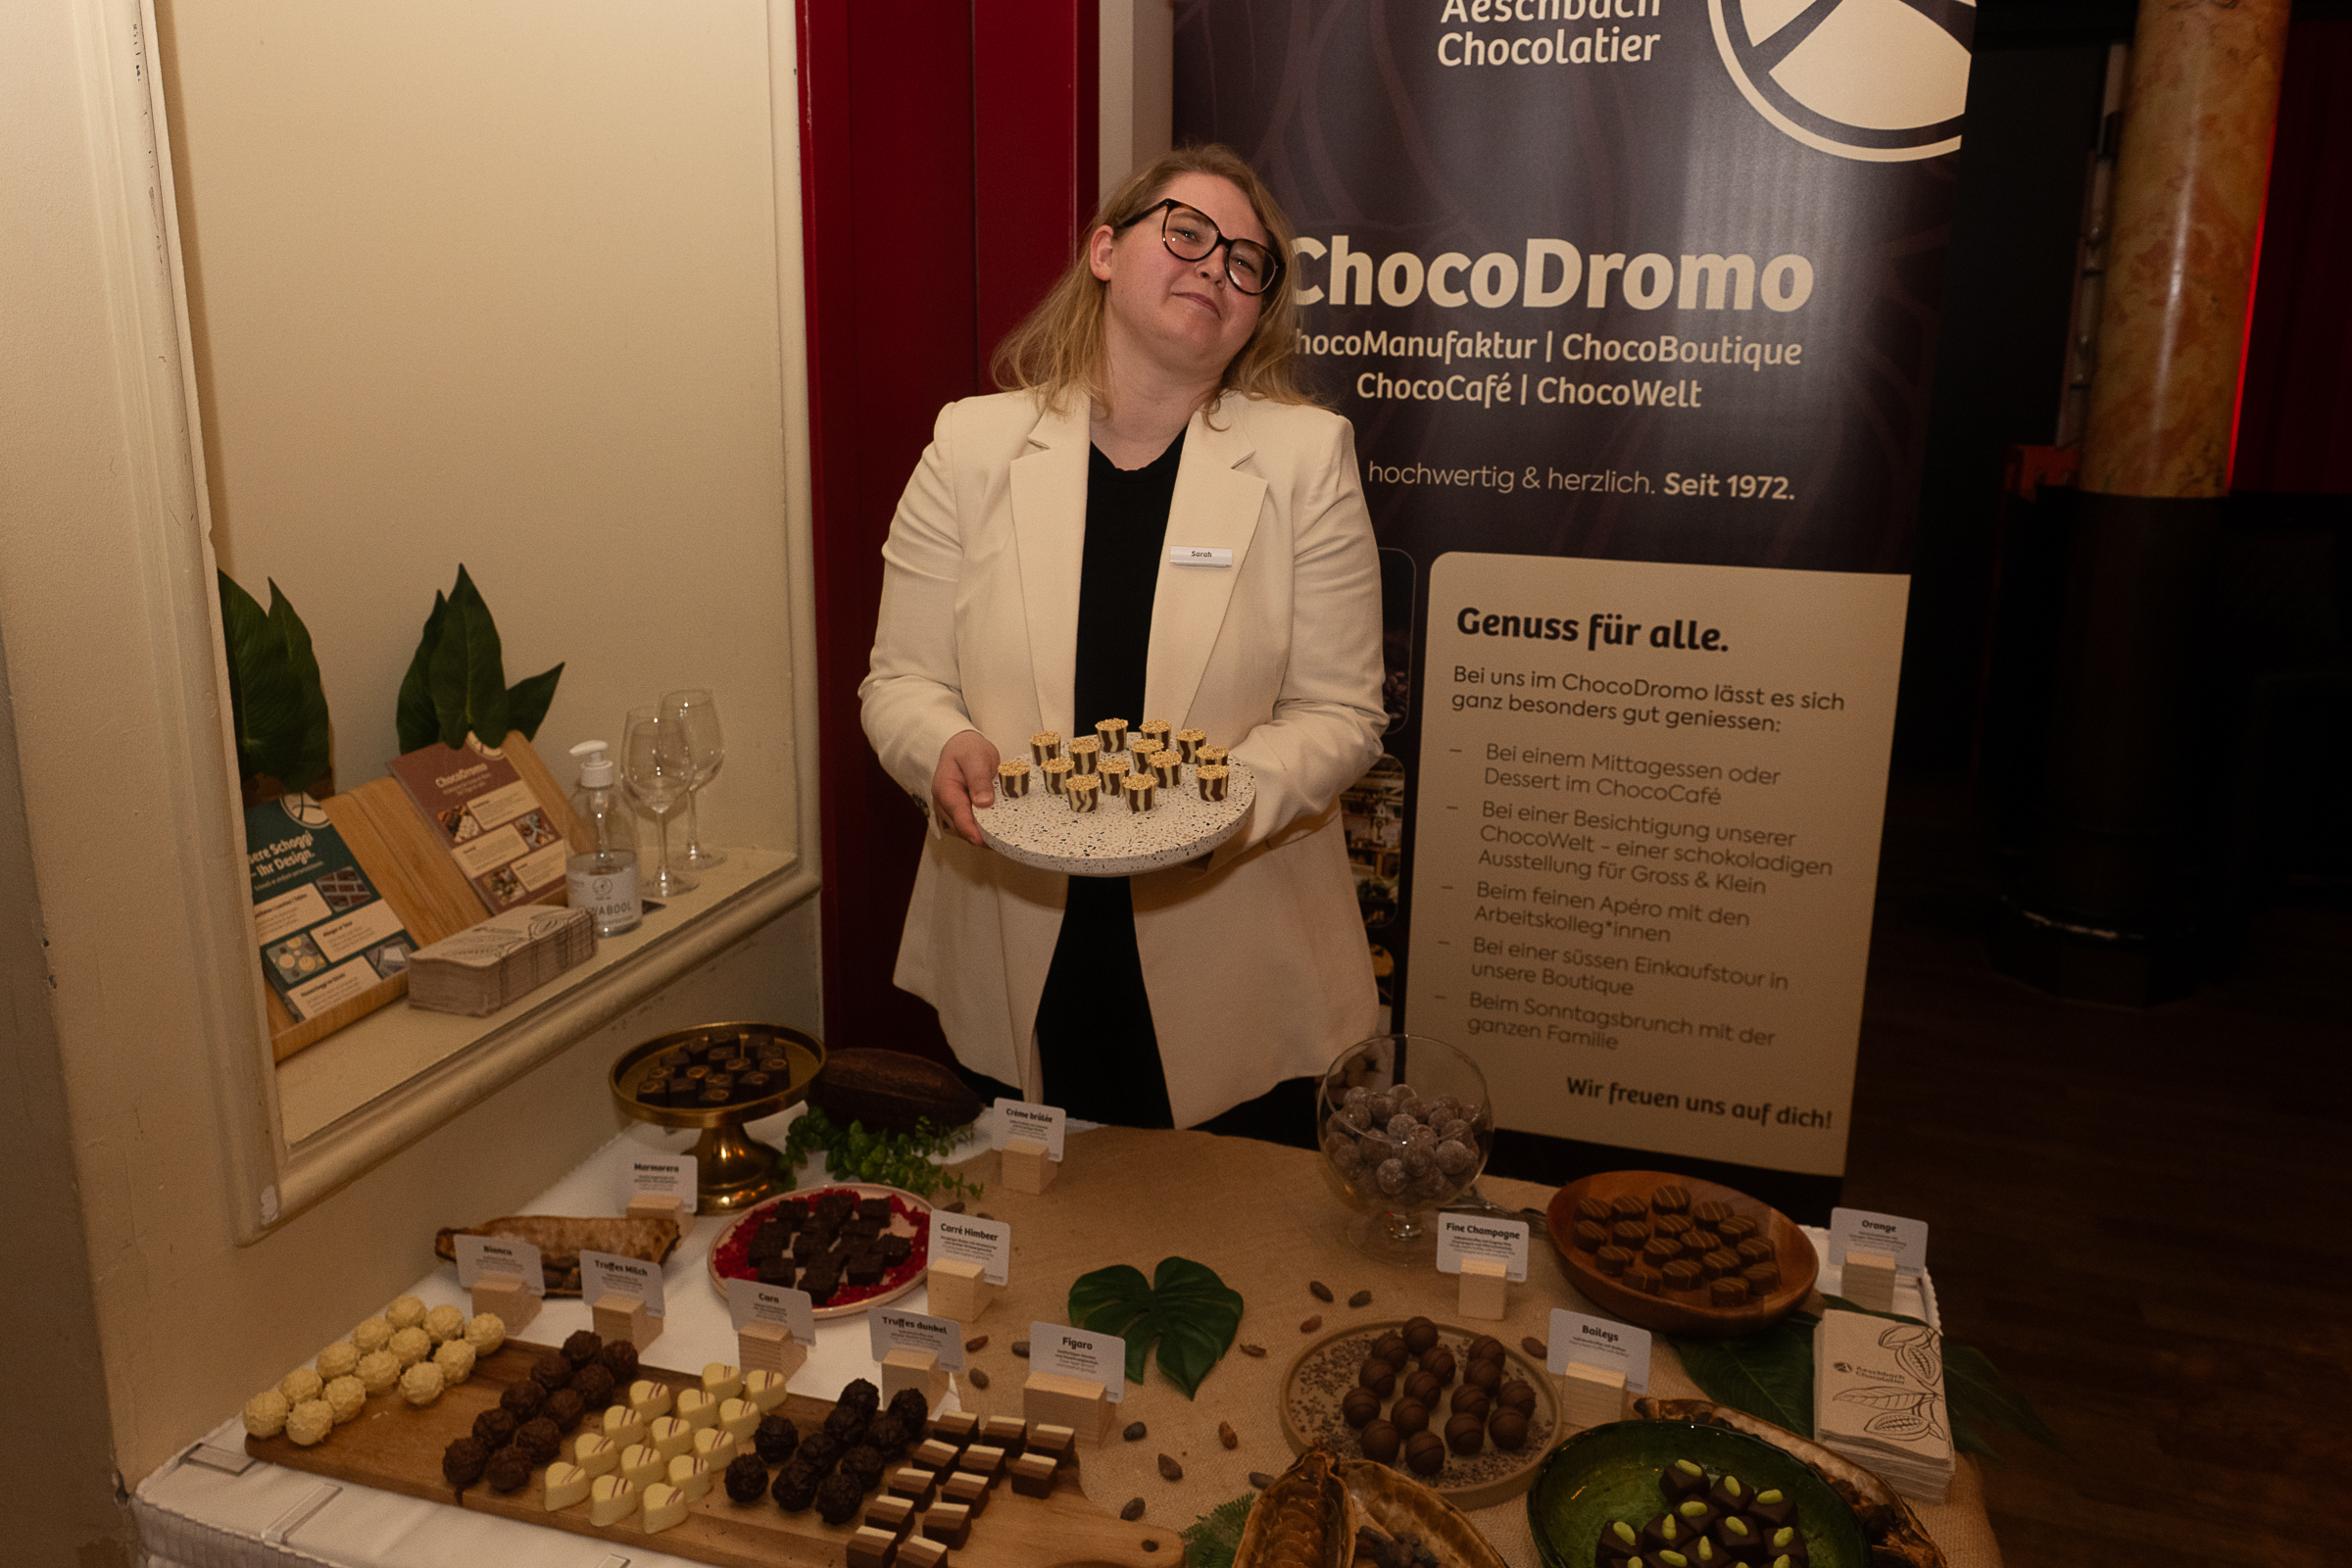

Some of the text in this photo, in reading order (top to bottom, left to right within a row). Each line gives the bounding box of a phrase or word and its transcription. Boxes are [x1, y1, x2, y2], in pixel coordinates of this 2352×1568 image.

[1438, 26, 1661, 67] Chocolatier
[1291, 235, 1814, 313] ChocoDromo
[1295, 328, 1538, 365] hocoManufaktur
[1562, 333, 1802, 371] ChocoBoutique
[1357, 372, 1512, 408] ChocoCafé
[1537, 376, 1702, 408] ChocoWelt
[1369, 461, 1795, 500] hochwertig & herzlich. Seit 1972.
[1456, 606, 1729, 653] Genuss für alle.
[1453, 664, 1845, 710] Bei uns im ChocoDromo lässt es sich
[1451, 693, 1781, 733] ganz besonders gut geniessen:
[1486, 742, 1781, 785] Bei einem Mittagessen oder
[1485, 766, 1722, 806] Dessert im ChocoCafé
[1482, 800, 1796, 847] Bei einer Besichtigung unserer
[248, 830, 314, 863] sere Schoggi
[256, 861, 275, 878] Ihr
[273, 849, 316, 870] Design.
[1480, 824, 1594, 853] ChocoWelt
[1616, 840, 1669, 859] einer
[1674, 847, 1833, 878] schokoladigen
[1478, 849, 1766, 894] Ausstellung für Gross & Klein
[1477, 880, 1750, 926] Beim feinen Apéro mit den
[1471, 964, 1634, 996] unsere Boutique
[1473, 936, 1788, 990] Bei einer süssen Einkaufstour in
[1467, 1018, 1619, 1051] ganzen Familie
[1469, 991, 1776, 1046] Beim Sonntagsbrunch mit der
[1005, 1108, 1028, 1119] Crème
[1566, 1076, 1833, 1130] Wir freuen uns auf dich!
[941, 1223, 998, 1242] Carré Himbeer
[1446, 1222, 1520, 1240] Fine Champagne
[1862, 1219, 1896, 1233] Orange
[595, 1259, 648, 1276] Truffes Milch
[882, 1316, 948, 1334] Truffes dunkel
[1062, 1337, 1093, 1350] Figaro
[1582, 1325, 1619, 1343] Baileys
